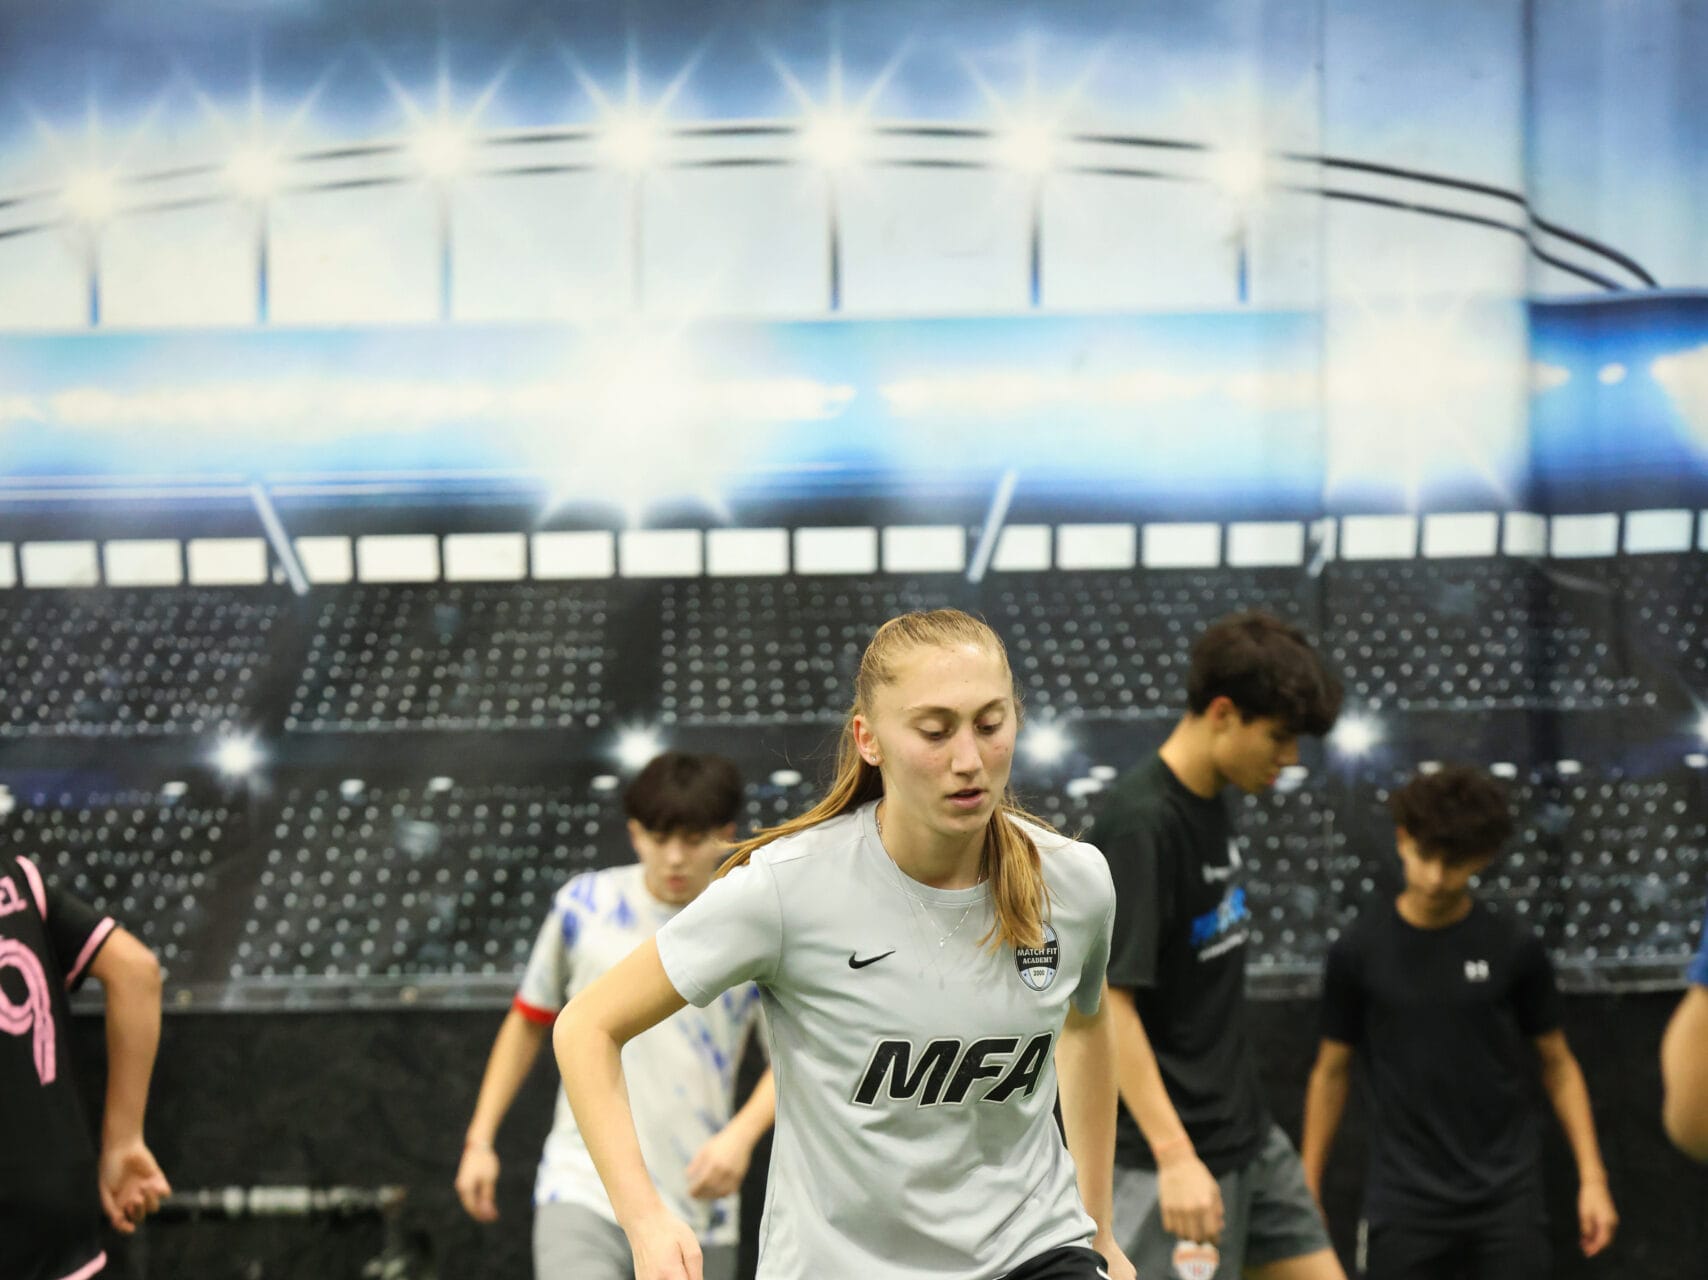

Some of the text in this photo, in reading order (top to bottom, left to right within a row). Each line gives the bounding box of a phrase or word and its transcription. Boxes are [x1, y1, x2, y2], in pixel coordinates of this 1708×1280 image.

[1017, 947, 1057, 956] MATCH FIT
[1022, 956, 1053, 964] ACADEMY
[852, 1031, 1053, 1107] MFA
